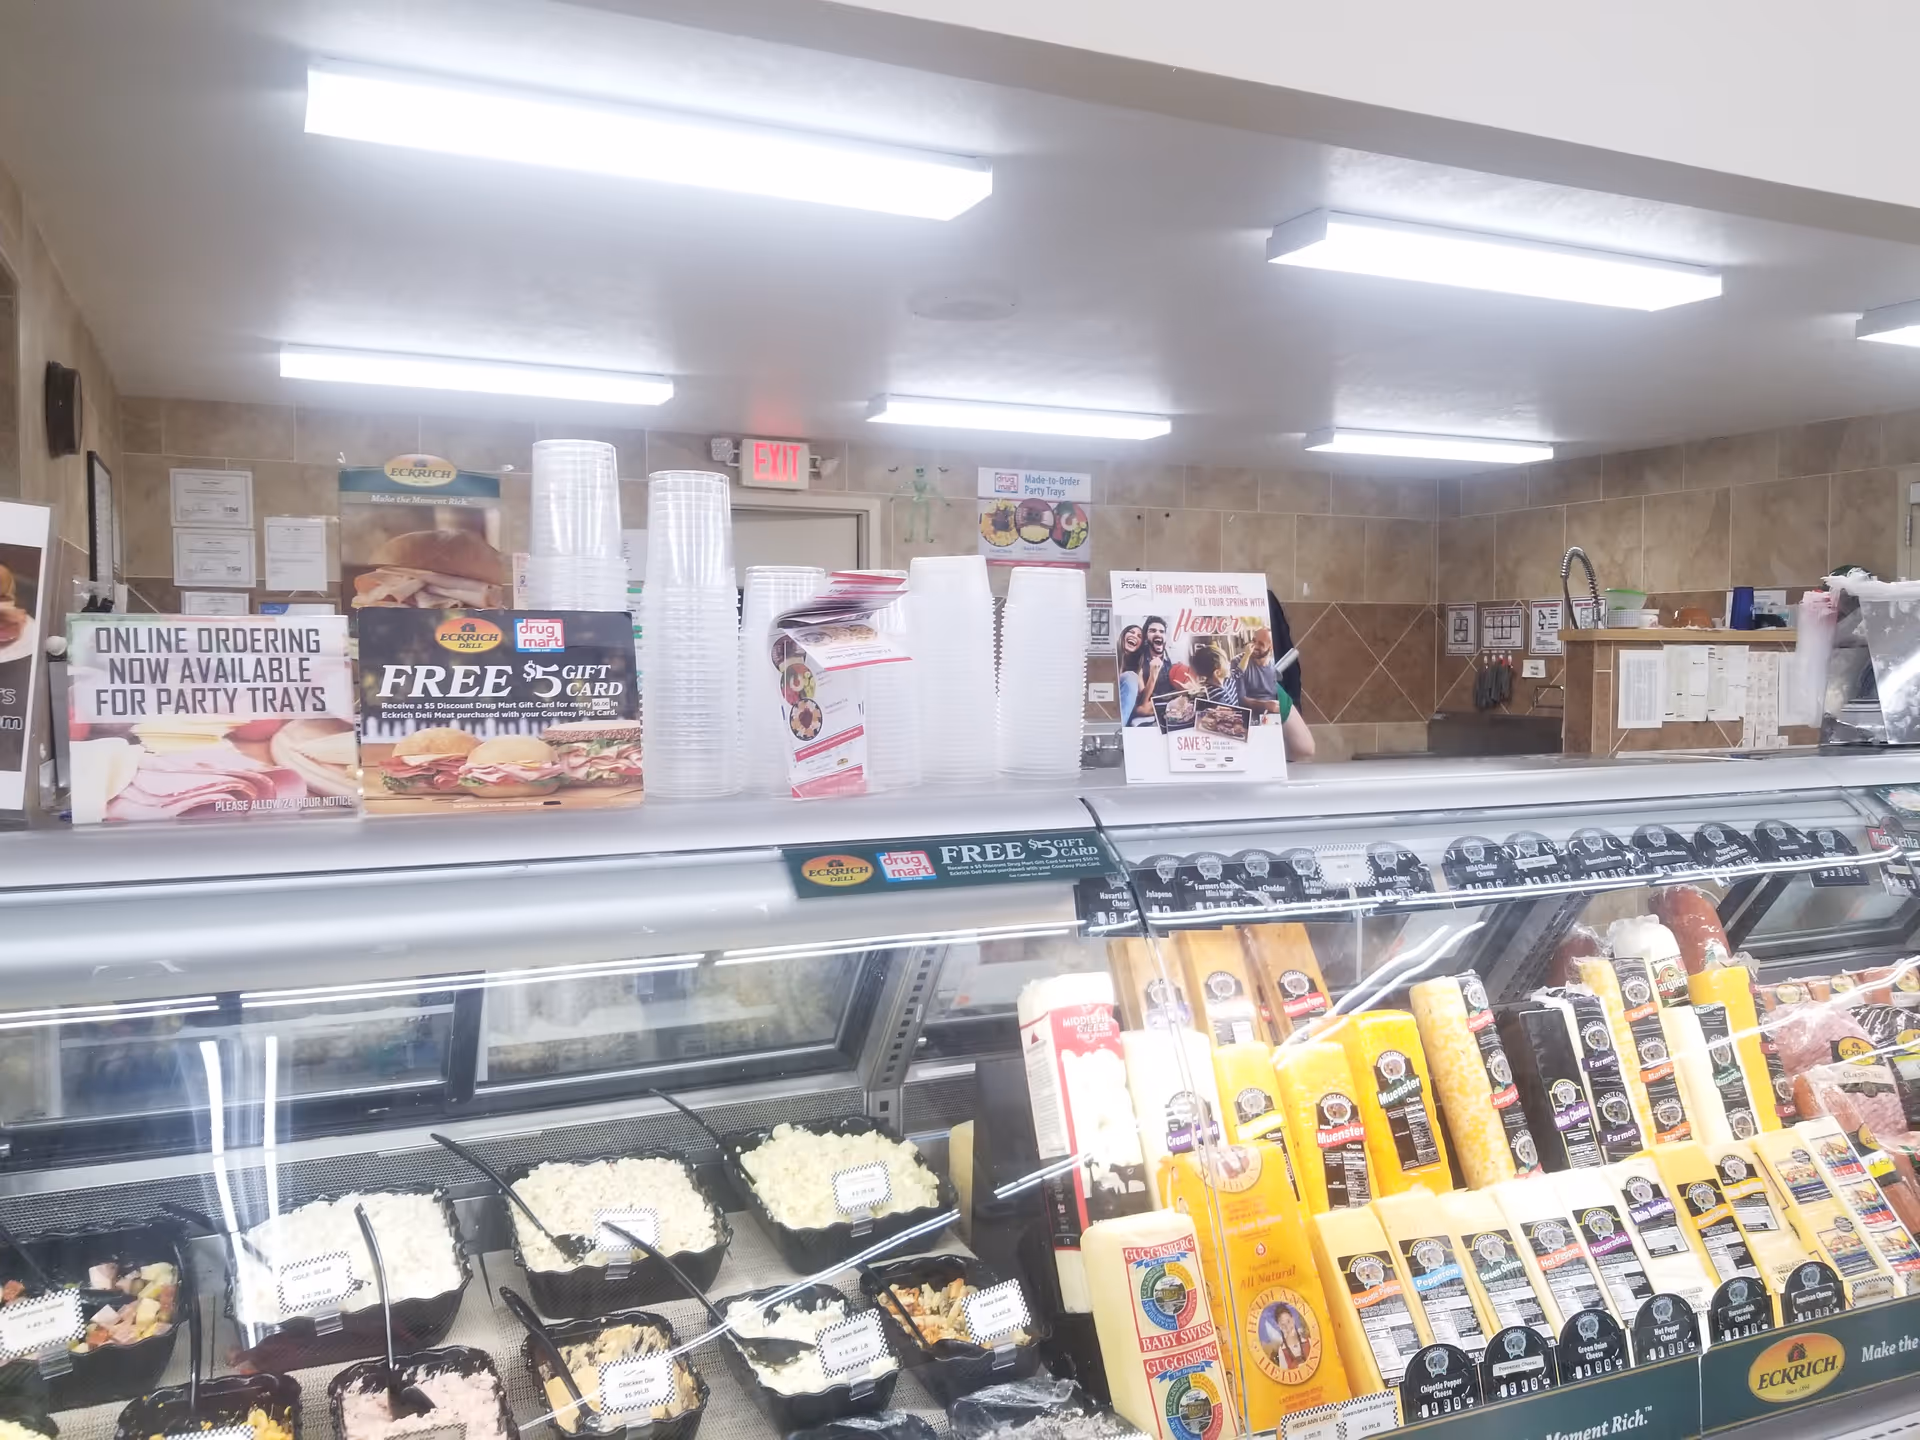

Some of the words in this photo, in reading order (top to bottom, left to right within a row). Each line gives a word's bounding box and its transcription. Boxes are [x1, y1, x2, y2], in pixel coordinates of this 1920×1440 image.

[753, 441, 801, 483] EXIT
[389, 466, 452, 480] ECKRICH
[996, 475, 1015, 485] drug
[1024, 474, 1080, 487] Made-to-Order
[1024, 485, 1045, 497] Party
[1046, 487, 1066, 497] Trays
[1121, 582, 1147, 590] Protein
[1155, 584, 1173, 594] FROM
[1174, 585, 1194, 594] HOOPS
[1196, 585, 1204, 594] TO
[1194, 597, 1207, 607] FILL
[1208, 598, 1225, 607] YOUR
[1226, 598, 1249, 607] SPRING
[1250, 598, 1266, 607] WITH
[519, 623, 555, 641] drug
[1172, 608, 1242, 642] flavor
[95, 627, 188, 654] ONLINE
[197, 627, 321, 654] ORDERING
[439, 632, 498, 643] ECKRICH
[523, 634, 563, 648] mart
[109, 657, 169, 684] NOW
[179, 657, 312, 684] AVAILABLE
[561, 664, 611, 679] GIFT
[376, 664, 513, 697] FREE
[522, 659, 563, 698] $5
[566, 681, 623, 697] CARD
[96, 688, 147, 715] FOR
[157, 687, 238, 715] PARTY
[246, 686, 327, 713] TRAYS
[381, 702, 416, 710] Receive
[424, 702, 435, 710] $5
[437, 702, 474, 710] Discount
[476, 701, 497, 711] Drug
[498, 701, 517, 709] Mart
[518, 701, 534, 709] Gift
[535, 701, 555, 709] Card
[556, 700, 568, 708] for
[570, 701, 592, 710] every
[381, 711, 414, 719] Eckrich
[457, 710, 499, 719] purchased
[501, 710, 519, 718] with
[521, 711, 540, 719] your
[541, 710, 577, 719] Courtesy
[578, 709, 595, 717] Plus
[596, 709, 618, 717] Card.
[1176, 736, 1201, 751] SAVE
[215, 800, 249, 812] PLEASE
[250, 799, 280, 811] ALLOW
[283, 798, 295, 809] 24
[296, 797, 321, 808] HOUR
[323, 795, 353, 808] NOTICE
[1053, 838, 1084, 848] GIFT
[939, 841, 1026, 865] FREE
[1028, 838, 1059, 859] $5
[1061, 846, 1099, 857] CARD
[882, 852, 923, 869] drug
[807, 864, 870, 878] ECKRICH
[829, 874, 856, 883] DELI
[891, 864, 932, 879] mart
[1099, 891, 1123, 900] Havarti
[1589, 1054, 1616, 1069] Farmers
[1378, 1076, 1421, 1106] Muenster
[1317, 1125, 1365, 1145] Muenster
[1606, 1127, 1638, 1143] Farmers
[1124, 1235, 1195, 1262] GUGGISBERG
[1590, 1233, 1629, 1255] Horseradish
[1540, 1256, 1554, 1268] Hot
[1240, 1276, 1255, 1290] All
[1257, 1265, 1297, 1285] Natural
[1479, 1266, 1502, 1282] Green
[1500, 1259, 1524, 1273] Onion
[1353, 1290, 1379, 1306] Chipotle
[830, 1331, 853, 1344] Chicken
[852, 1324, 869, 1336] Salad
[1141, 1333, 1178, 1353] BABY
[1180, 1321, 1214, 1344] SWISS
[1577, 1344, 1594, 1354] Green
[1594, 1340, 1608, 1351] Onion
[1860, 1339, 1898, 1364] Make
[1897, 1335, 1920, 1355] the
[1145, 1343, 1218, 1375] GUGGISBERG
[1585, 1350, 1604, 1361] Cheese
[618, 1379, 644, 1389] Chicken
[1420, 1380, 1445, 1395] Chipotle
[1443, 1377, 1463, 1389] Pepper
[1432, 1389, 1453, 1400] Cheese
[1306, 1418, 1319, 1427] ANN
[1319, 1412, 1338, 1424] LACEY
